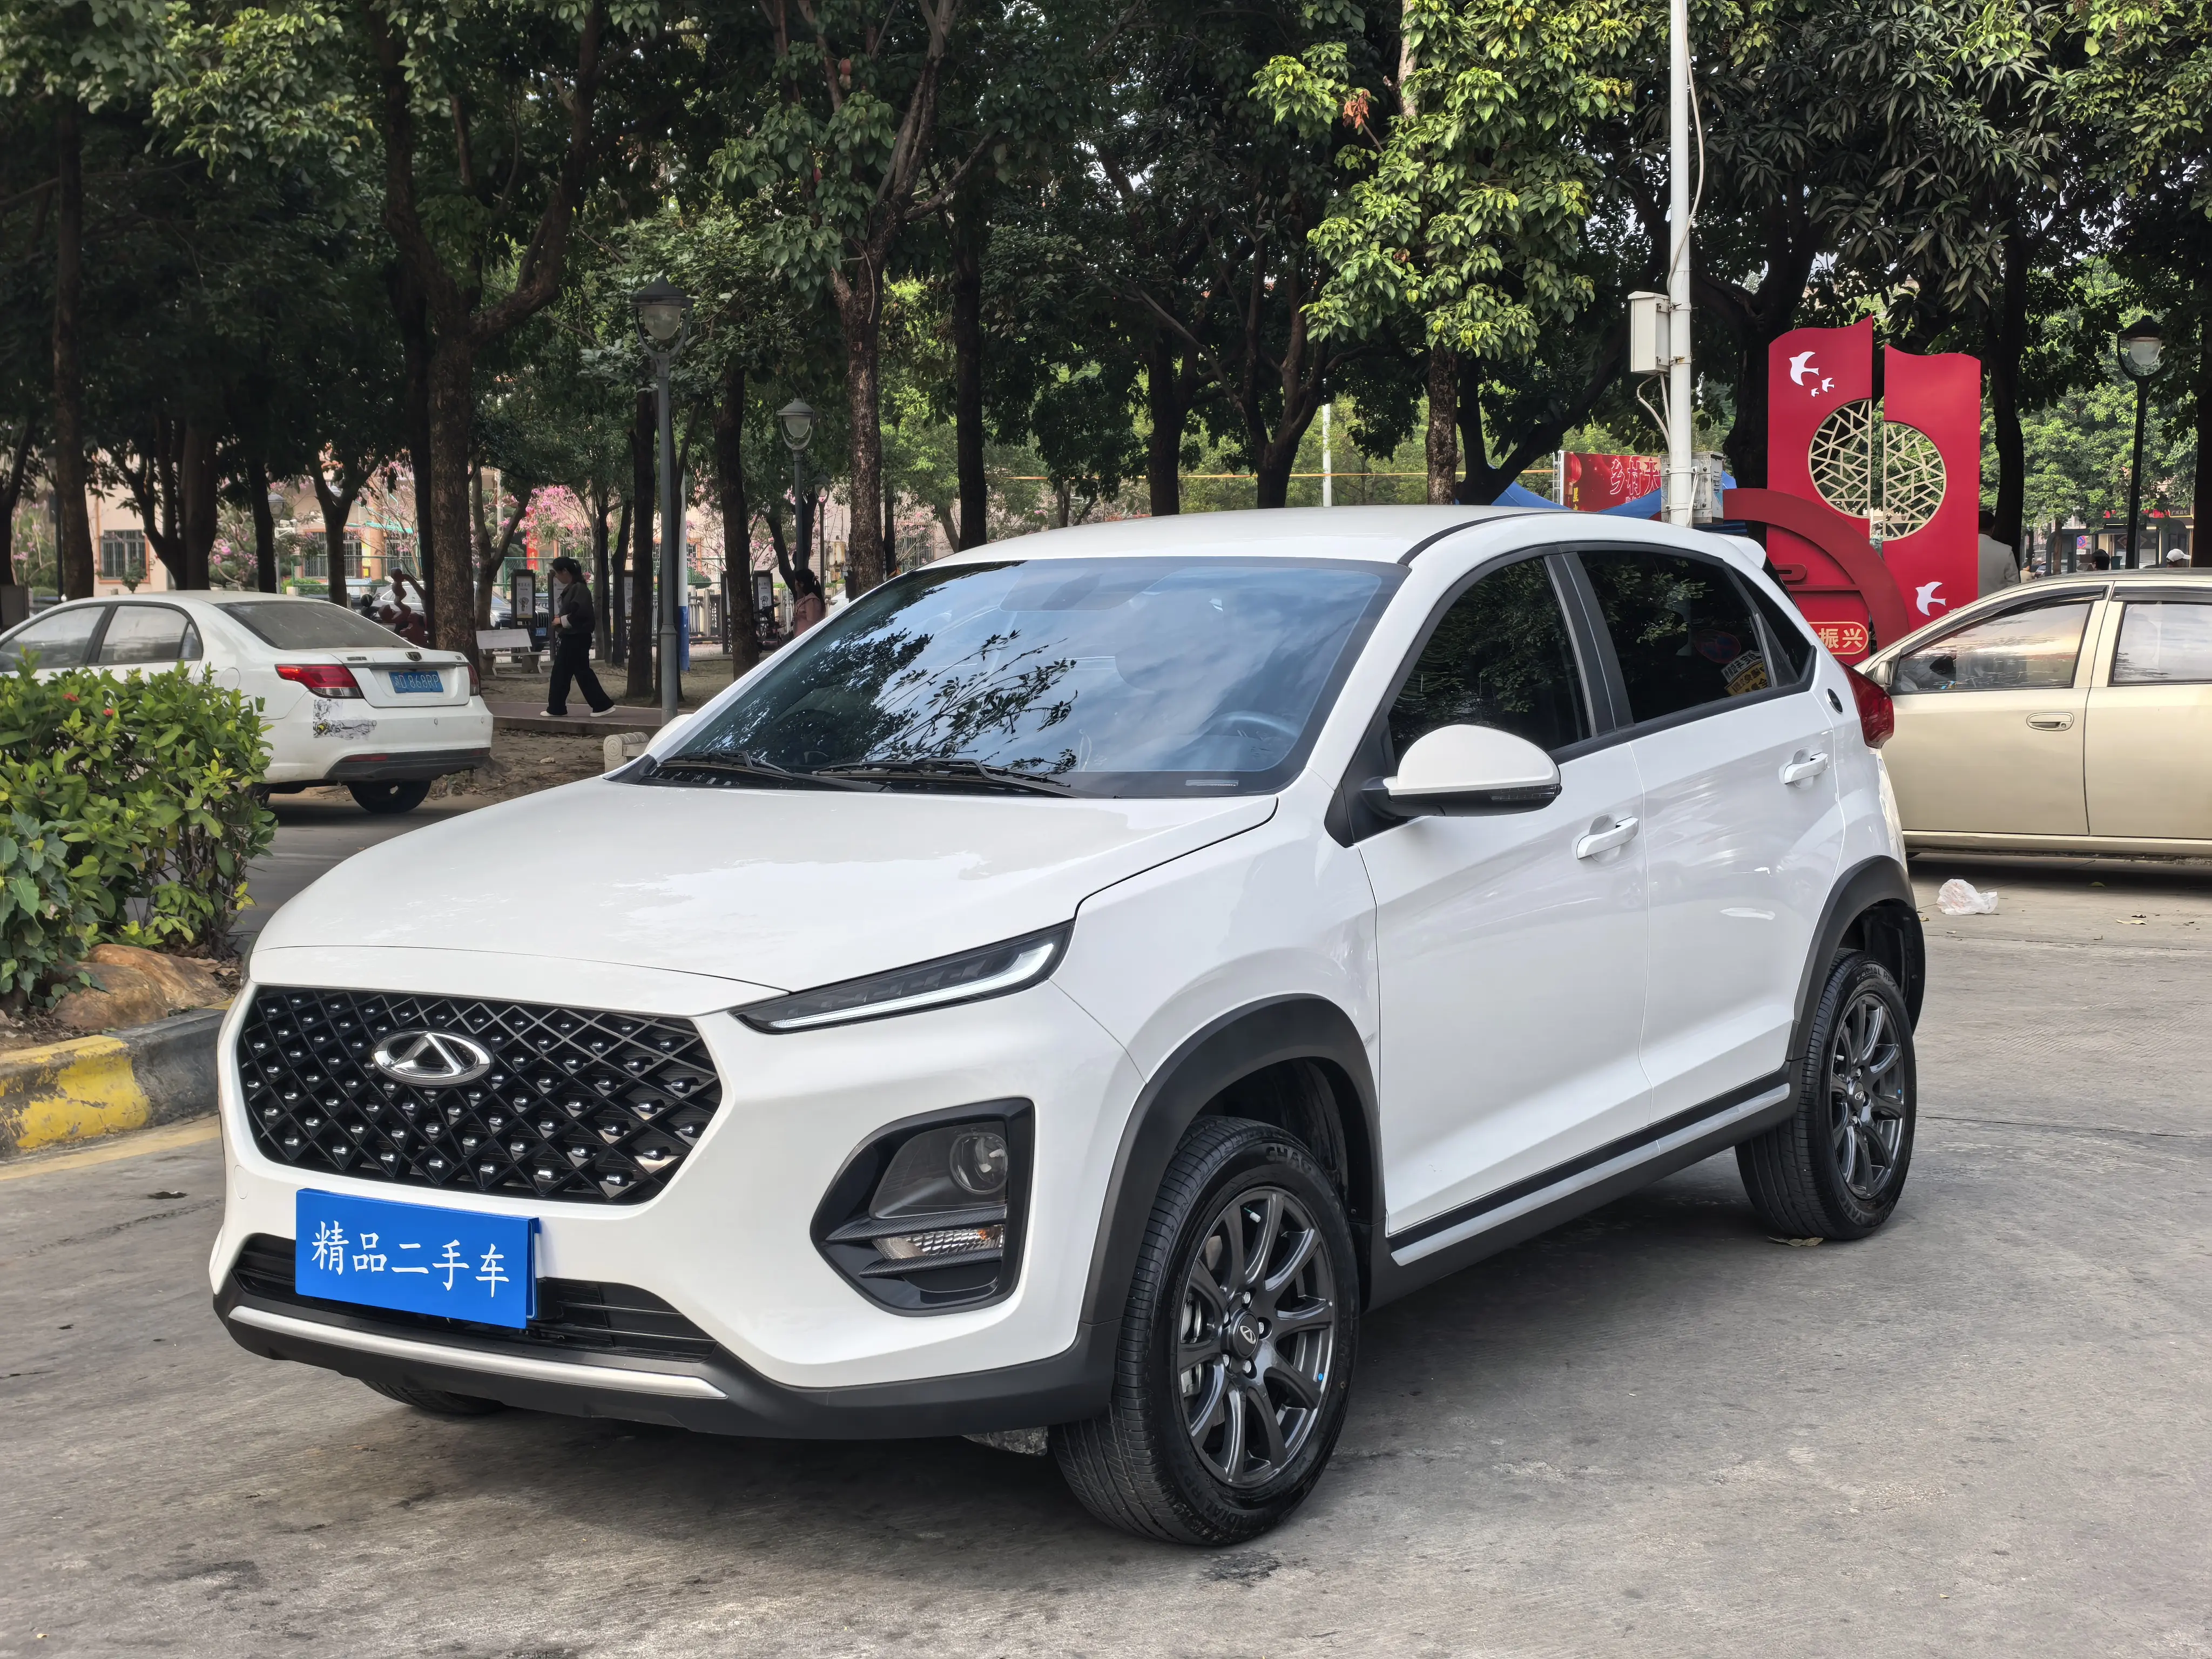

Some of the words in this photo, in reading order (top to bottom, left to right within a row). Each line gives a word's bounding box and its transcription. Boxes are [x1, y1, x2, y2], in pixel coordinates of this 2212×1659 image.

[1610, 458, 1660, 495] 乡村大
[1818, 628, 1863, 649] 振兴
[312, 1220, 509, 1298] 精品二手车
